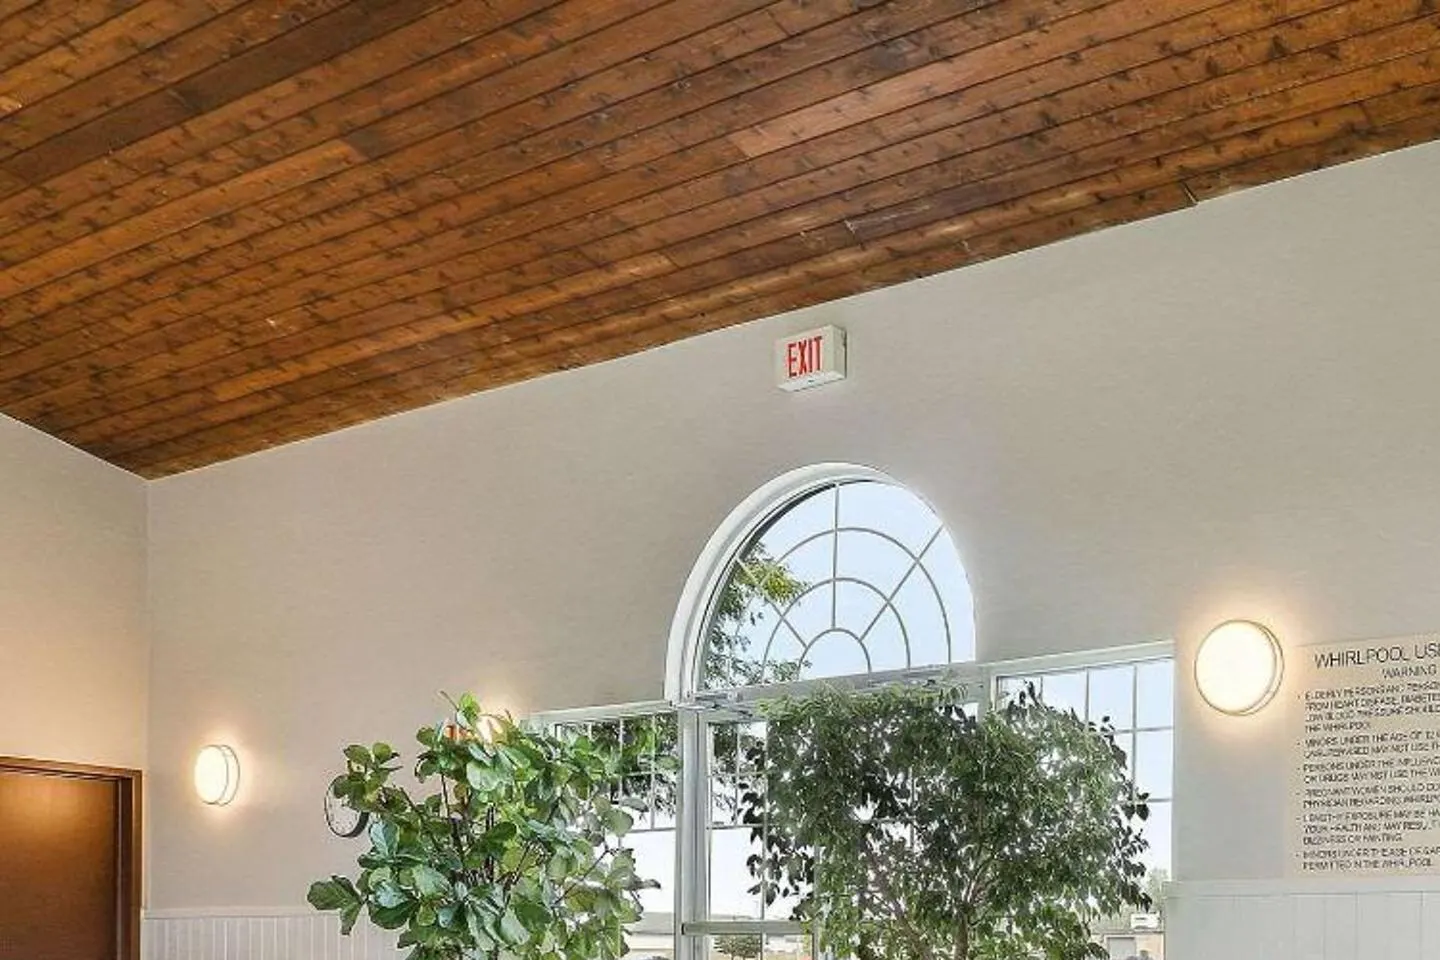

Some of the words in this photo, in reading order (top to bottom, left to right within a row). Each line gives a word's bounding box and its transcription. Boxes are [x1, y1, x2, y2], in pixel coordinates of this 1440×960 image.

[787, 335, 823, 378] EXIT
[1313, 646, 1409, 669] WHIRLPOOL
[1382, 663, 1437, 679] WARNING
